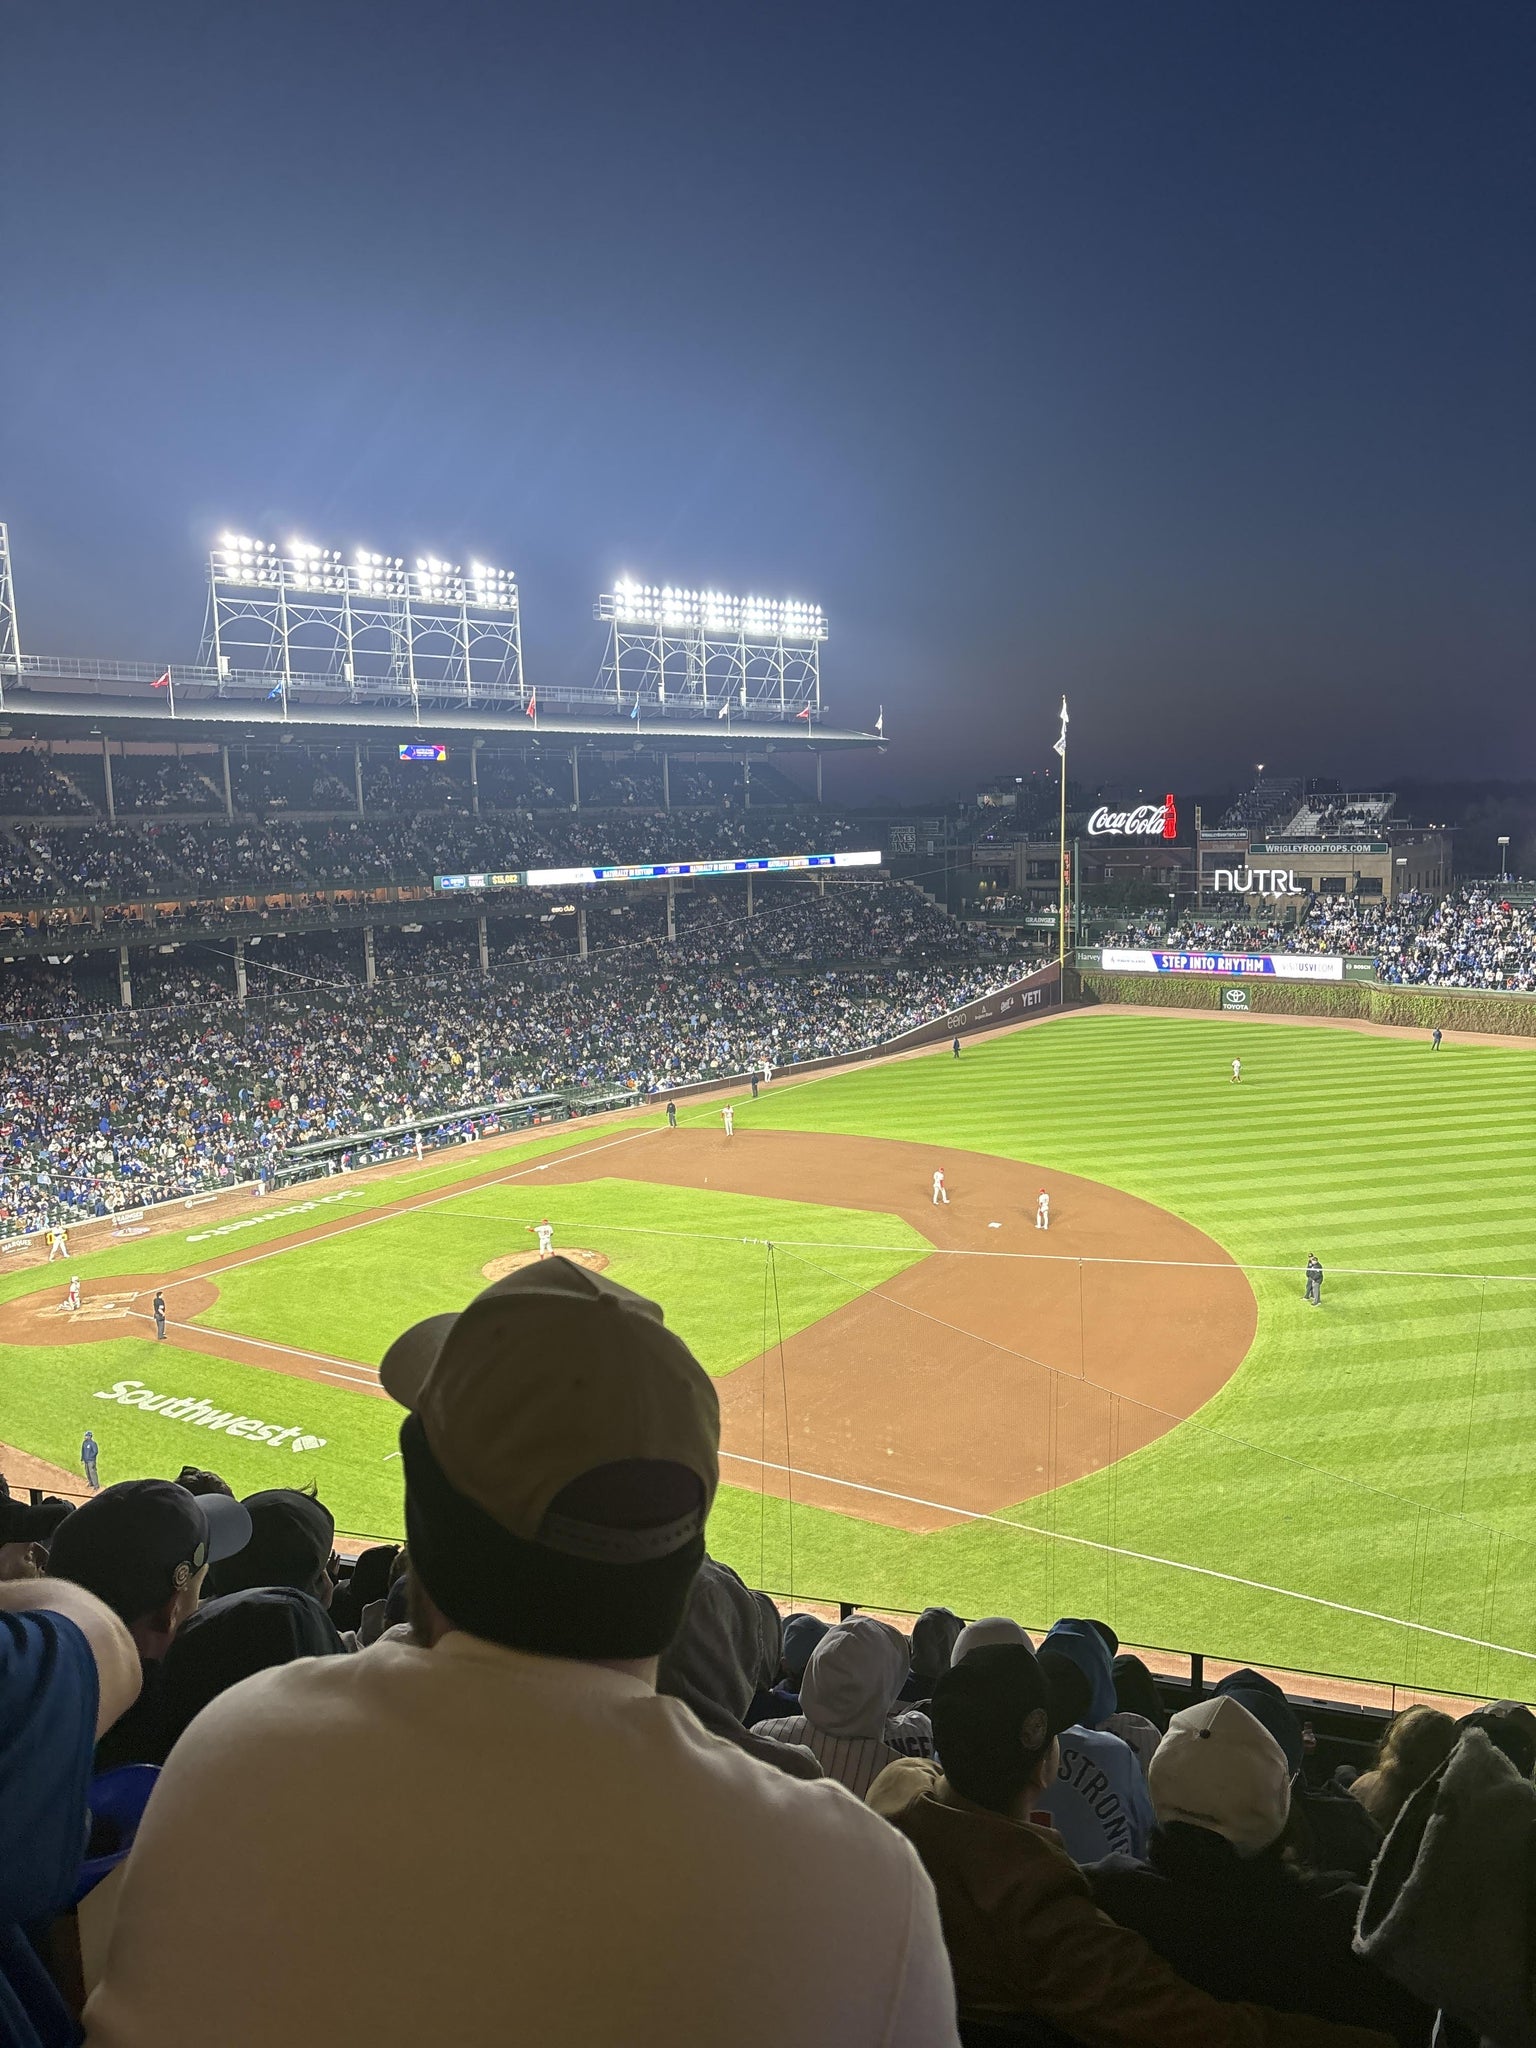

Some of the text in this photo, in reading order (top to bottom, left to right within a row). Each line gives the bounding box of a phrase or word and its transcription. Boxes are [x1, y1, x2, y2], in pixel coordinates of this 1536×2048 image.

[1088, 805, 1169, 835] Coca-Cola
[1265, 844, 1371, 853] WRIGLEYROOFTOPS.COM
[1077, 952, 1101, 962] Harvey
[1162, 955, 1264, 972] STEP INTO RHYTHM
[1021, 989, 1041, 1007] YETI
[1222, 1003, 1249, 1011] TOYOTA
[947, 1012, 967, 1029] eero
[202, 1190, 366, 1236] Southwest
[1, 1238, 33, 1252] MARQUEE
[92, 1380, 304, 1447] Southwest
